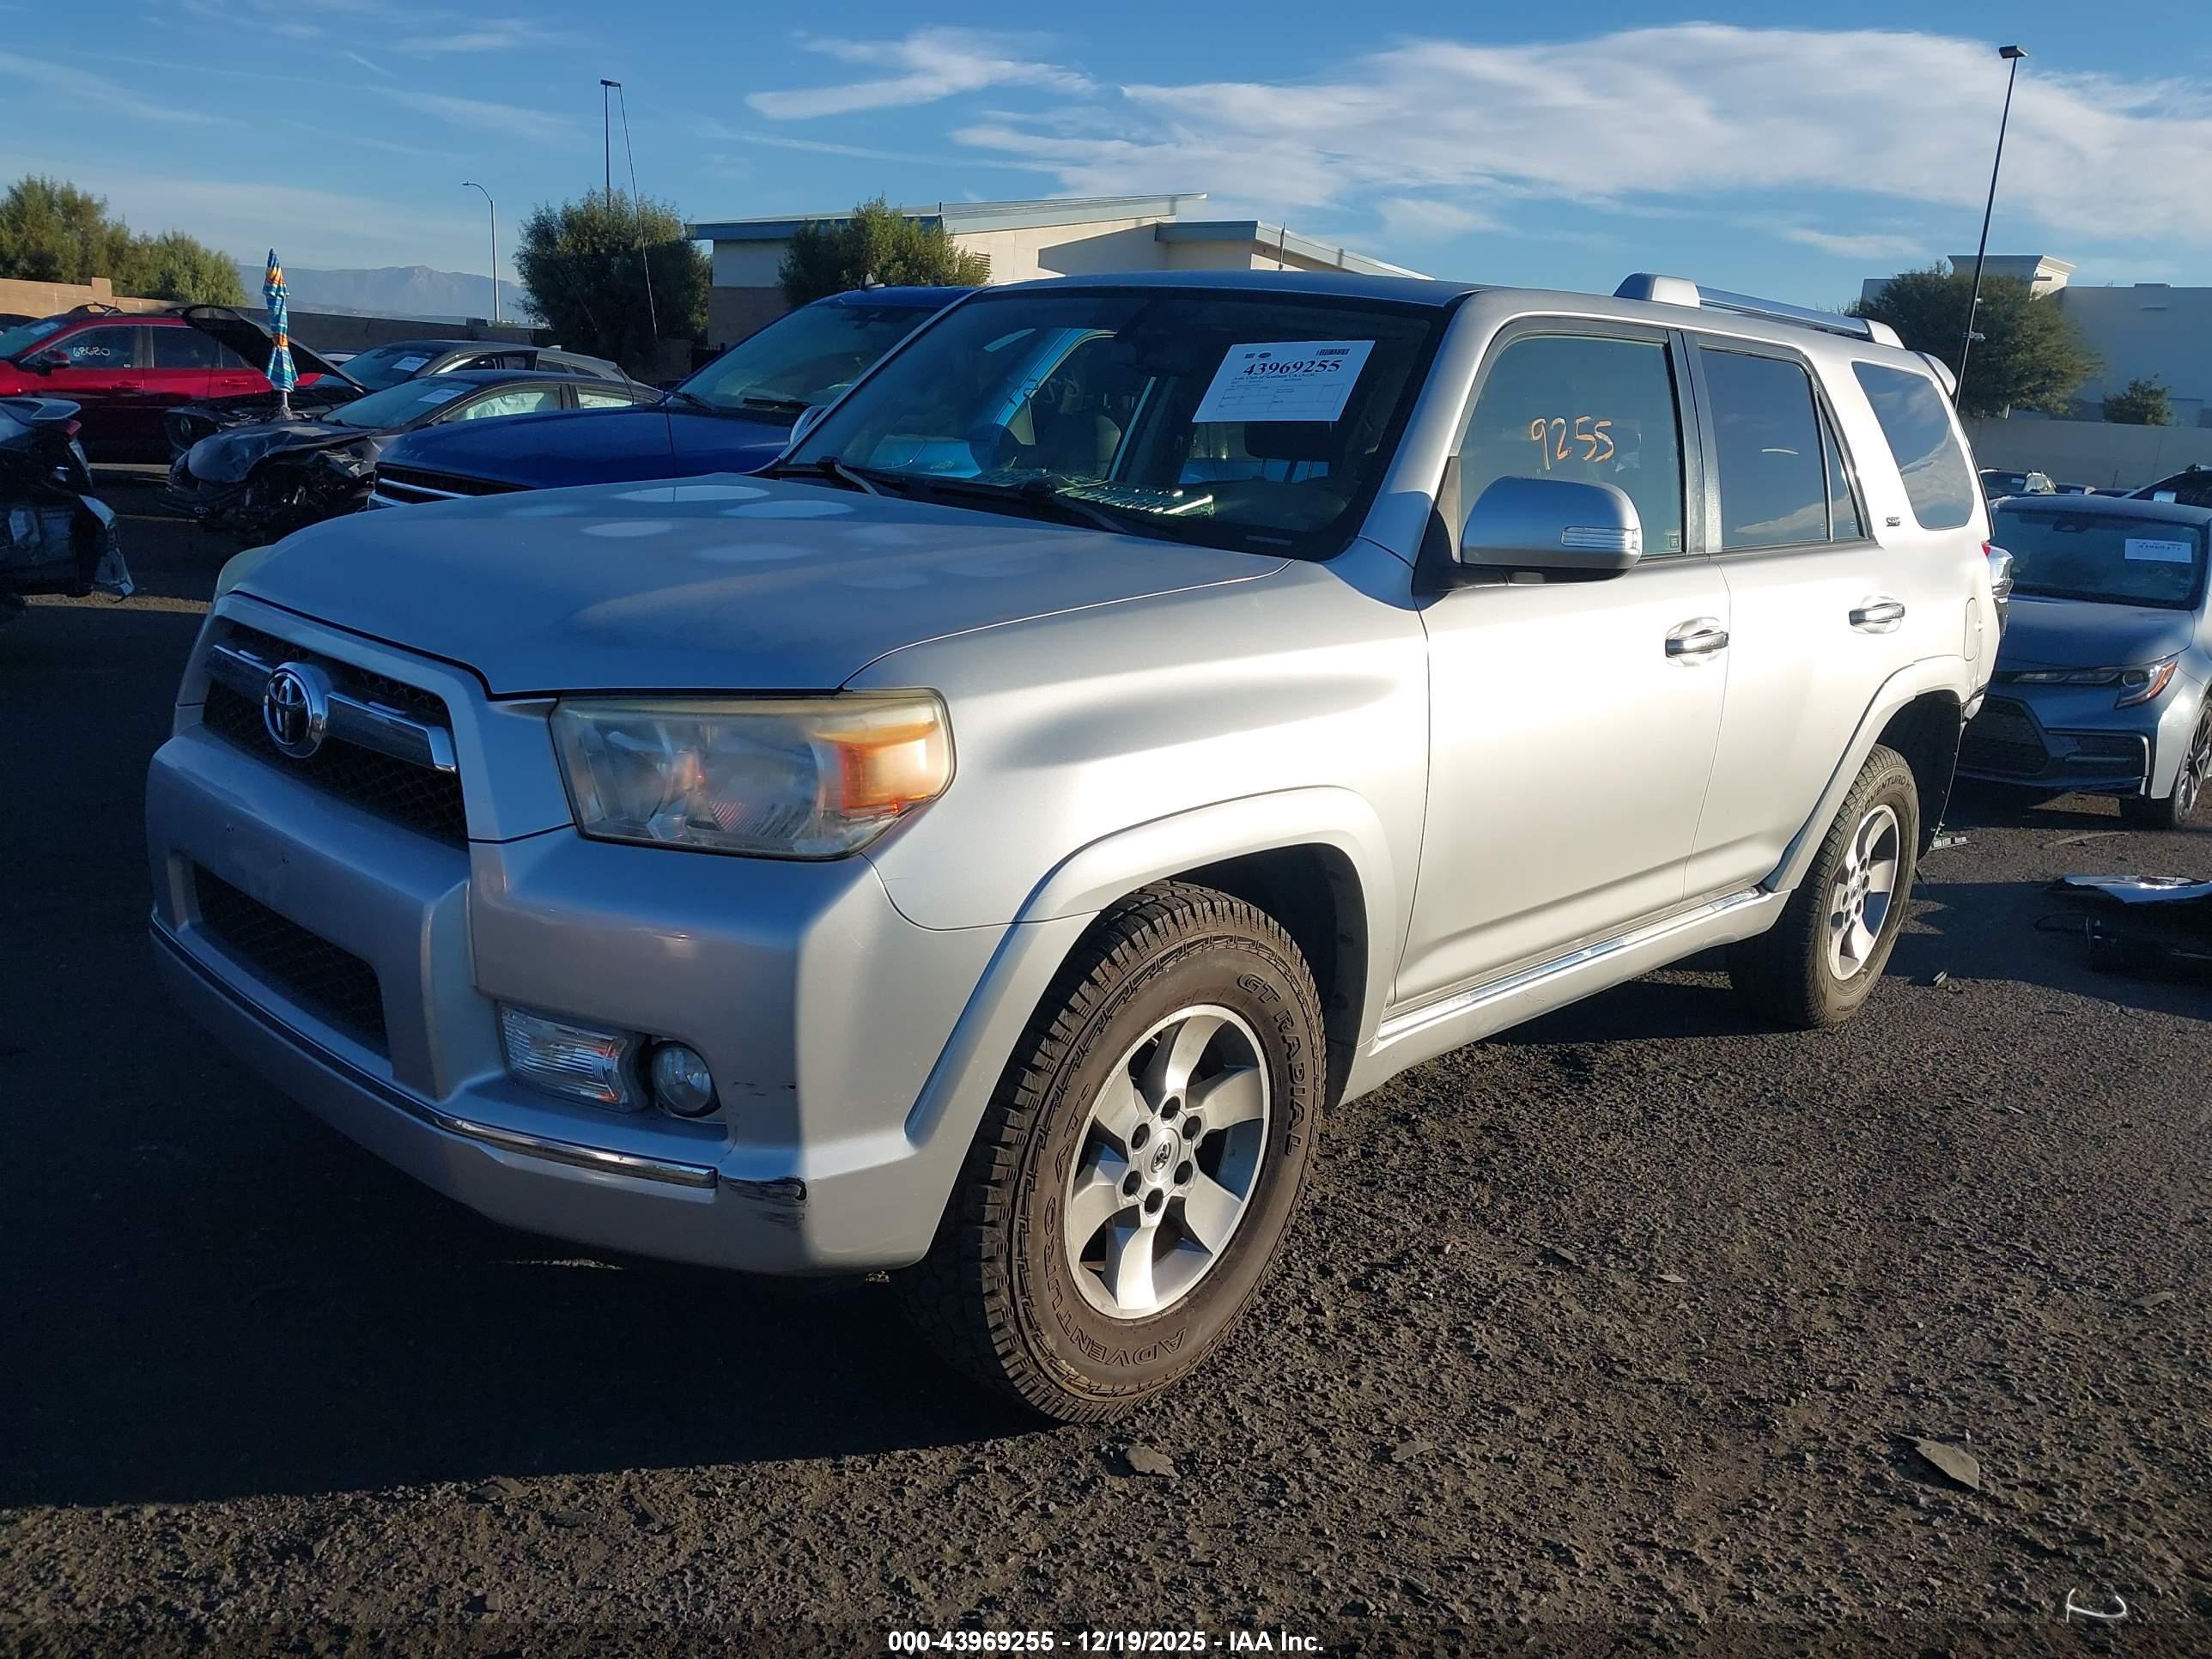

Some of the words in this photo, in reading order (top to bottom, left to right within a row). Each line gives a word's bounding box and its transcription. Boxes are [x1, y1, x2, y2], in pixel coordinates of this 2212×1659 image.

[1243, 359, 1343, 376] 43969255
[1530, 415, 1614, 471] 9255
[1237, 973, 1281, 1004] GT
[1273, 1009, 1306, 1157] RADIAL
[1043, 1194, 1188, 1368] ADVENTURO
